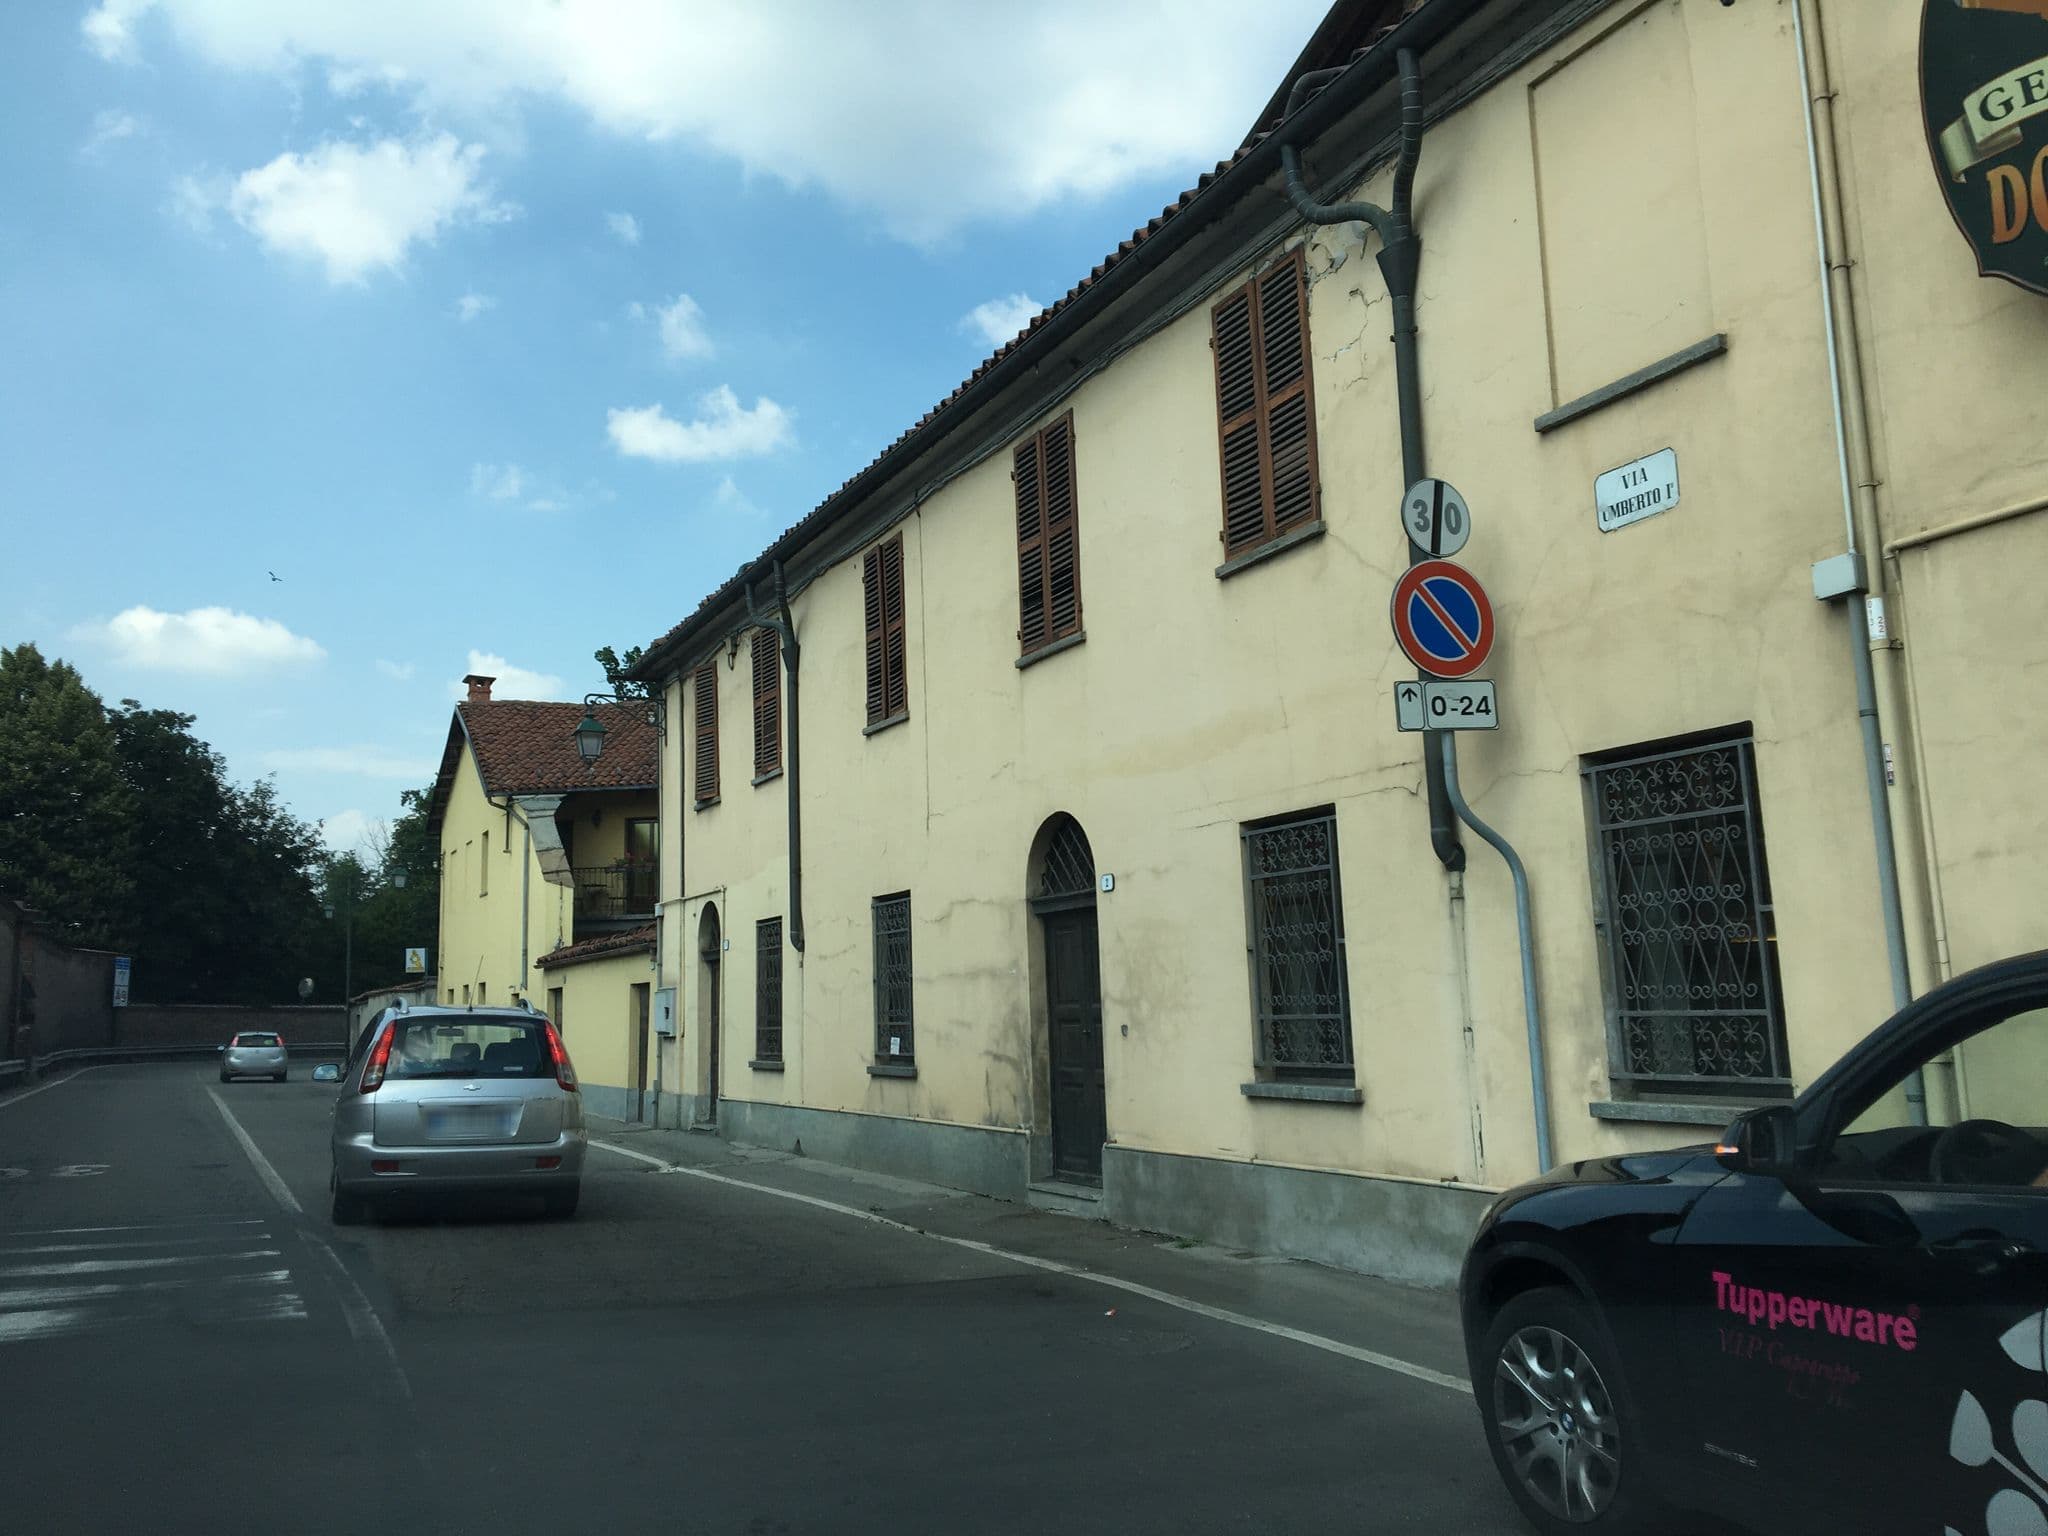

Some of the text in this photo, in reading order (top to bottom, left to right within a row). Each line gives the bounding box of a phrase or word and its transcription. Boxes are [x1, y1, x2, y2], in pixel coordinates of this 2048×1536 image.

[1621, 467, 1649, 489] VIA
[1412, 498, 1463, 536] 30
[1431, 695, 1492, 717] 0-24
[1712, 1271, 1918, 1352] Tupperware
